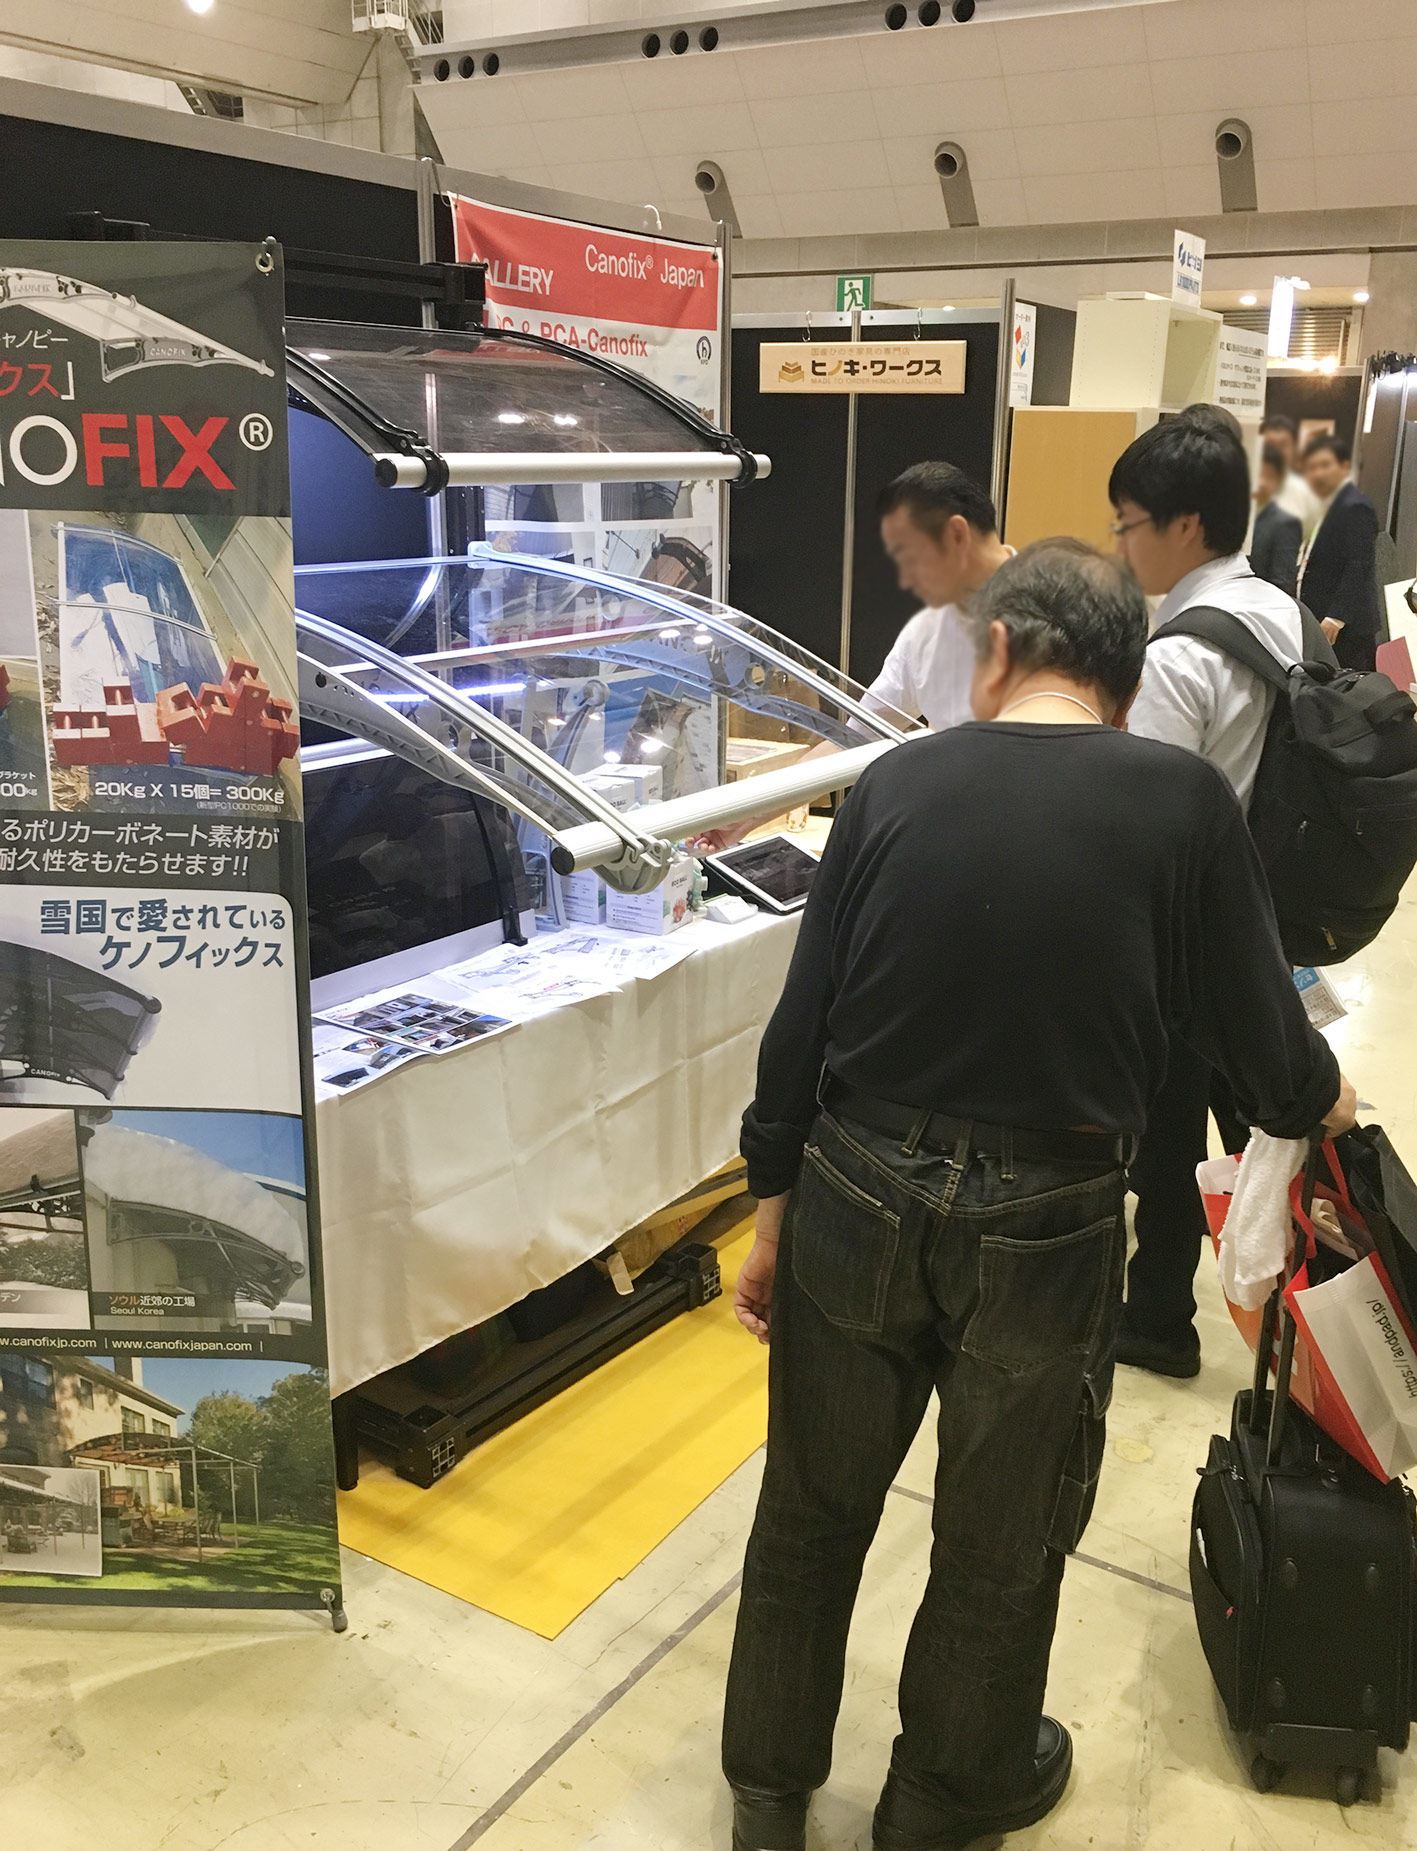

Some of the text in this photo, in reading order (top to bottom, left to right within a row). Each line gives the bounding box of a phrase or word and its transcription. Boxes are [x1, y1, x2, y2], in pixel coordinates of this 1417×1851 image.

[660, 258, 705, 290] Japan
[540, 321, 649, 357] PCA-Canofix
[810, 359, 943, 377] ヒノキ・ワークス
[810, 378, 943, 386] MADE TO ORDER HINOKI FURNITURE
[0, 412, 273, 491] OFIX®
[95, 781, 146, 799] 20Kg
[226, 785, 285, 805] 300Kg
[1, 818, 280, 850] るポリカーボネート素材が
[40, 898, 286, 935] 雪国で愛されている
[99, 935, 284, 970] ケノフィックス
[108, 1295, 196, 1308] ソウル近郊の工場
[110, 1306, 165, 1316] Seoul Korea
[111, 1339, 252, 1352] www.canofixjapan.com
